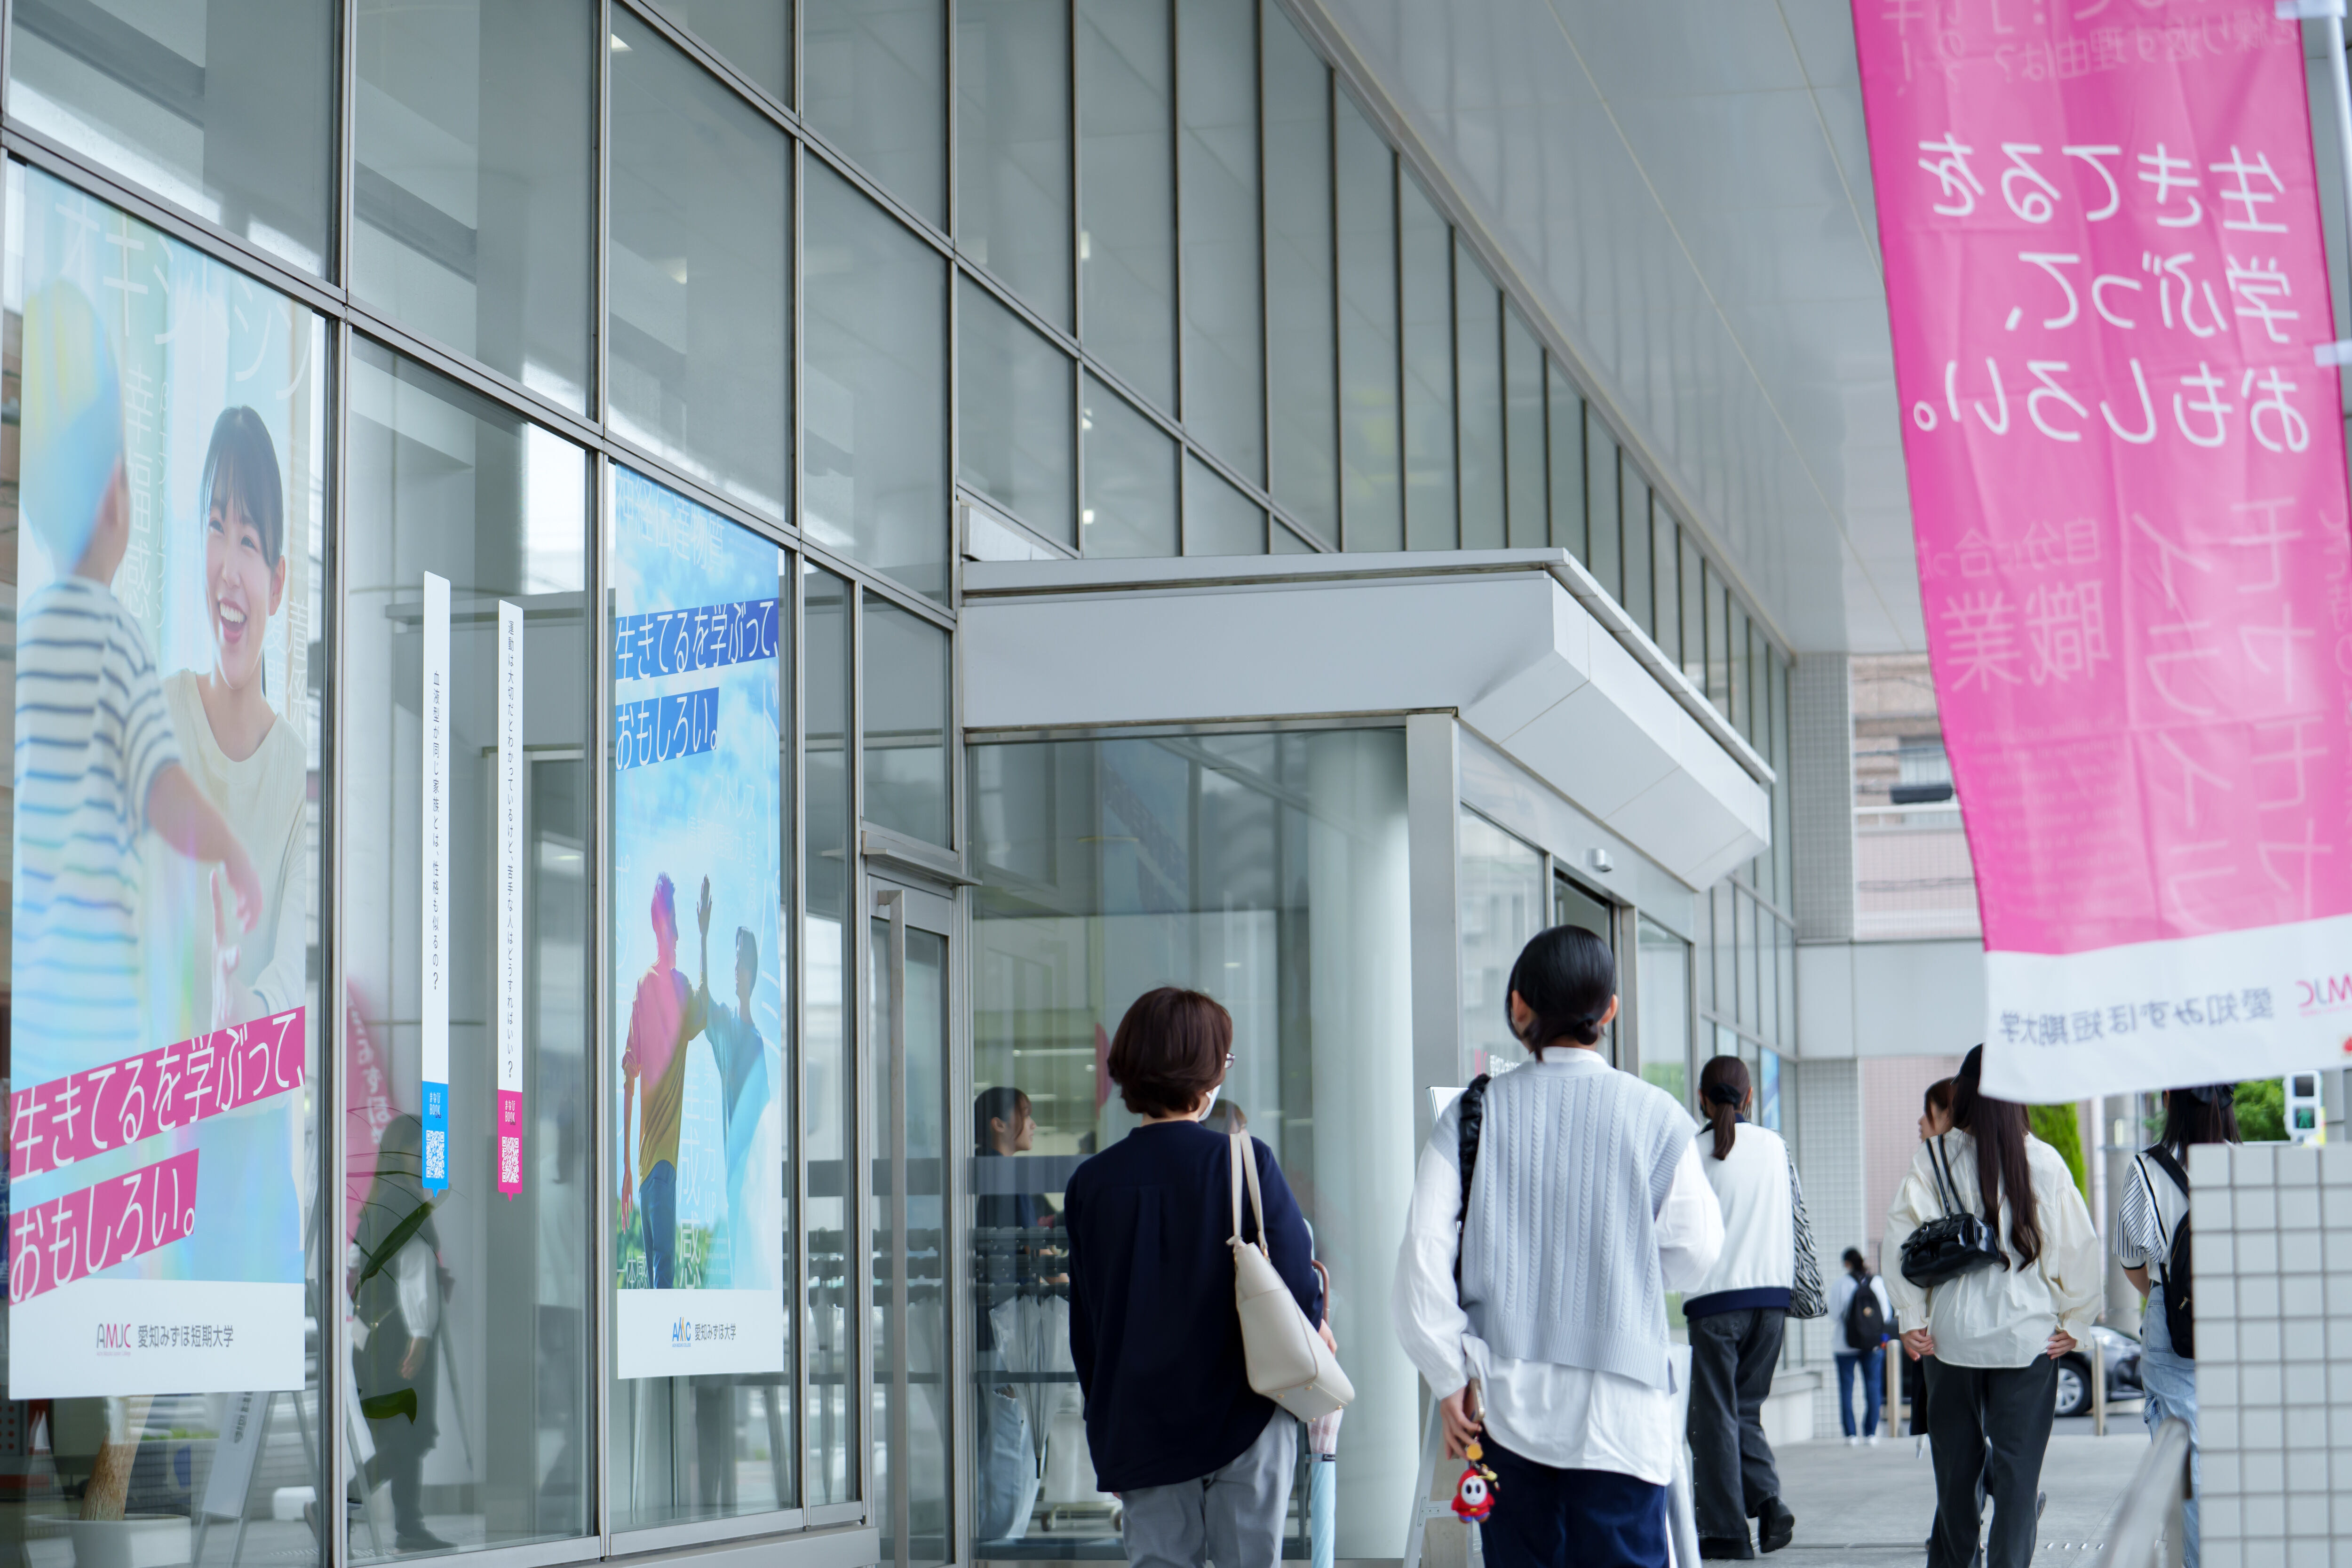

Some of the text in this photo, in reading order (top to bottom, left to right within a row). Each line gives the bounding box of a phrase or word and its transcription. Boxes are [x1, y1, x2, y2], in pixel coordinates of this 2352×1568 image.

[616, 466, 725, 572] 神経伝達物質
[616, 601, 779, 683] 生きてるを学ぶって、
[616, 694, 718, 771] おもしろい。
[10, 1012, 304, 1183] 生きてるを学ぶって、
[10, 1166, 196, 1304] おもしろい。
[96, 1323, 132, 1348] AMJC
[138, 1324, 234, 1349] 愛知みずほ短期大学
[695, 1323, 736, 1341] 愛知みずほ大学
